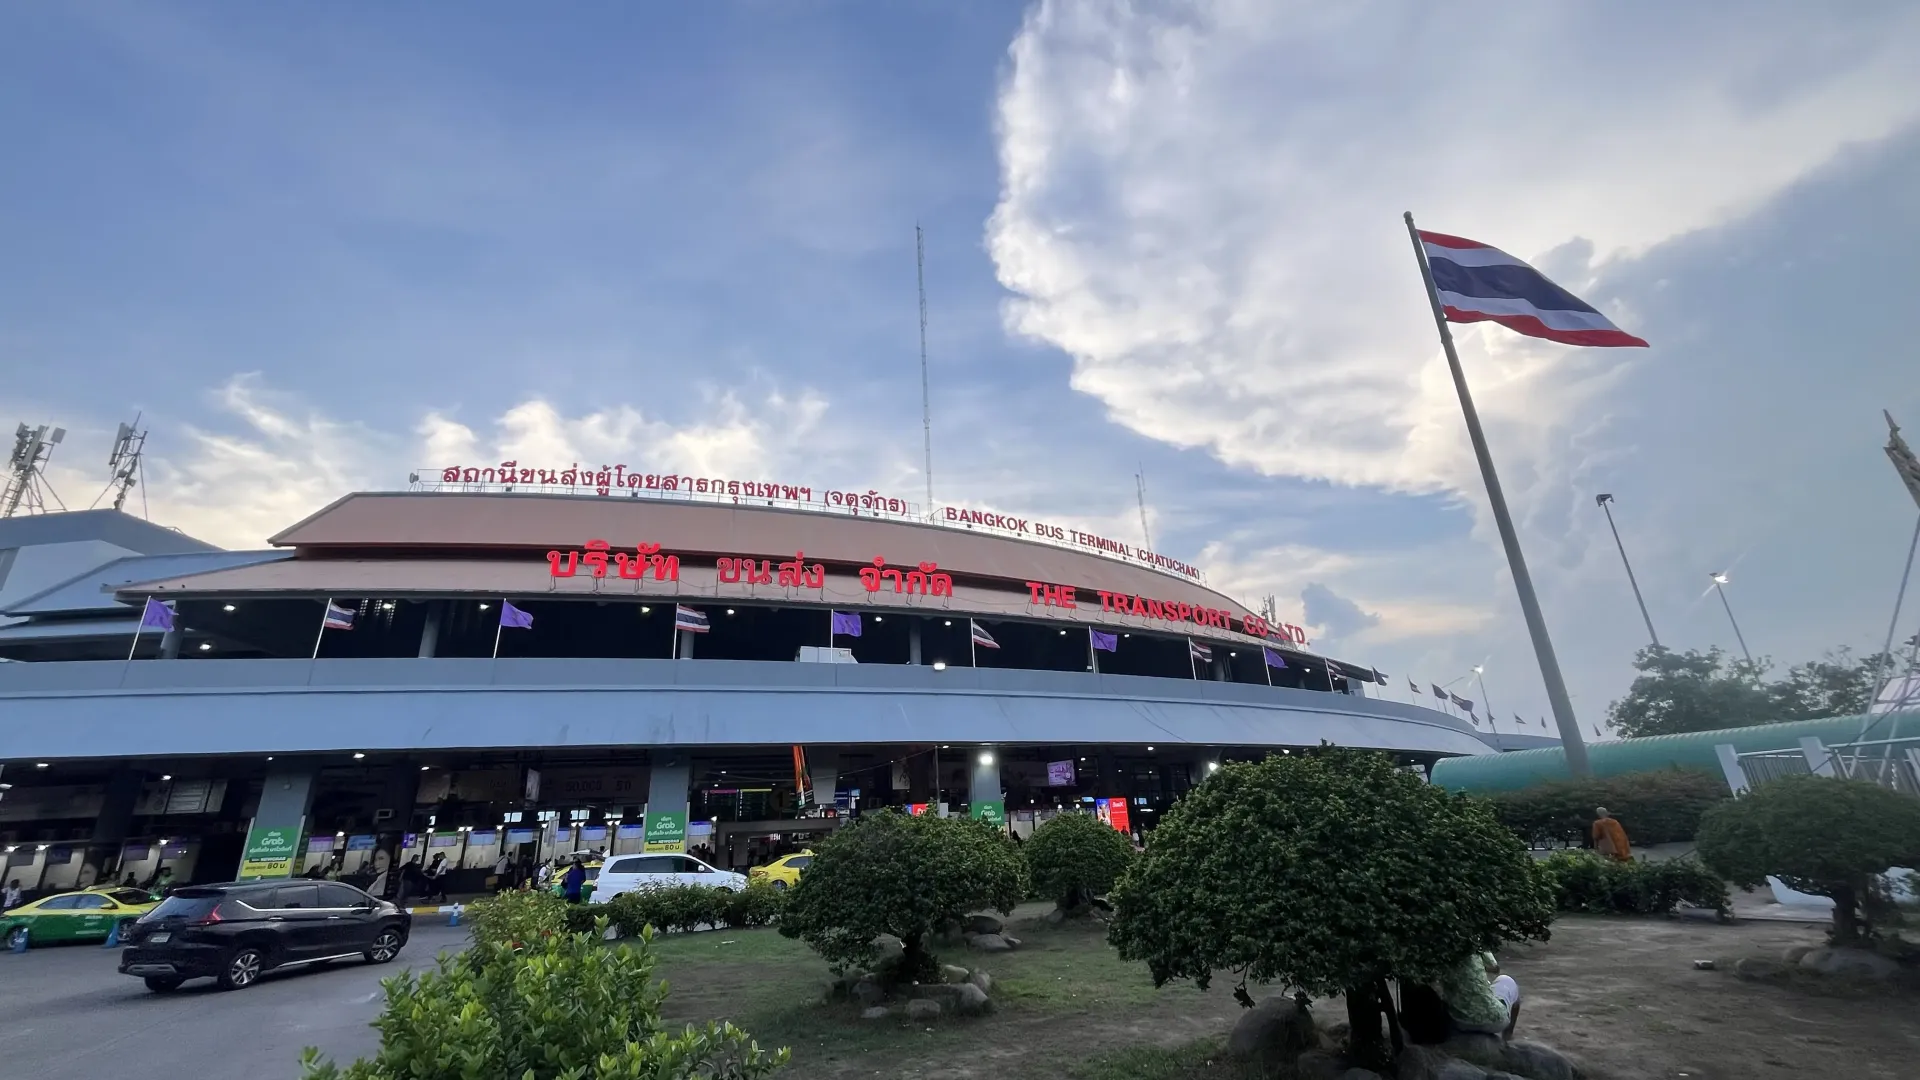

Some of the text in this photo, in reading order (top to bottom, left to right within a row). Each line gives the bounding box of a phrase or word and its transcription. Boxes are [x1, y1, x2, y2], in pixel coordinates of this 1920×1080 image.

[443, 460, 907, 516] สถานีขนส่งผู้โดยสารกรุงเทพฯ (จตุจักร)
[547, 539, 953, 597] บริษัท ขนส่ง จำกัด
[946, 506, 1200, 580] BANGKOK BUS TERMINAL (CHATUCHAK)
[1026, 581, 1076, 609] THE
[1097, 590, 1231, 630] TRANSPORT
[261, 836, 285, 846] Grab
[656, 821, 676, 830] Grab
